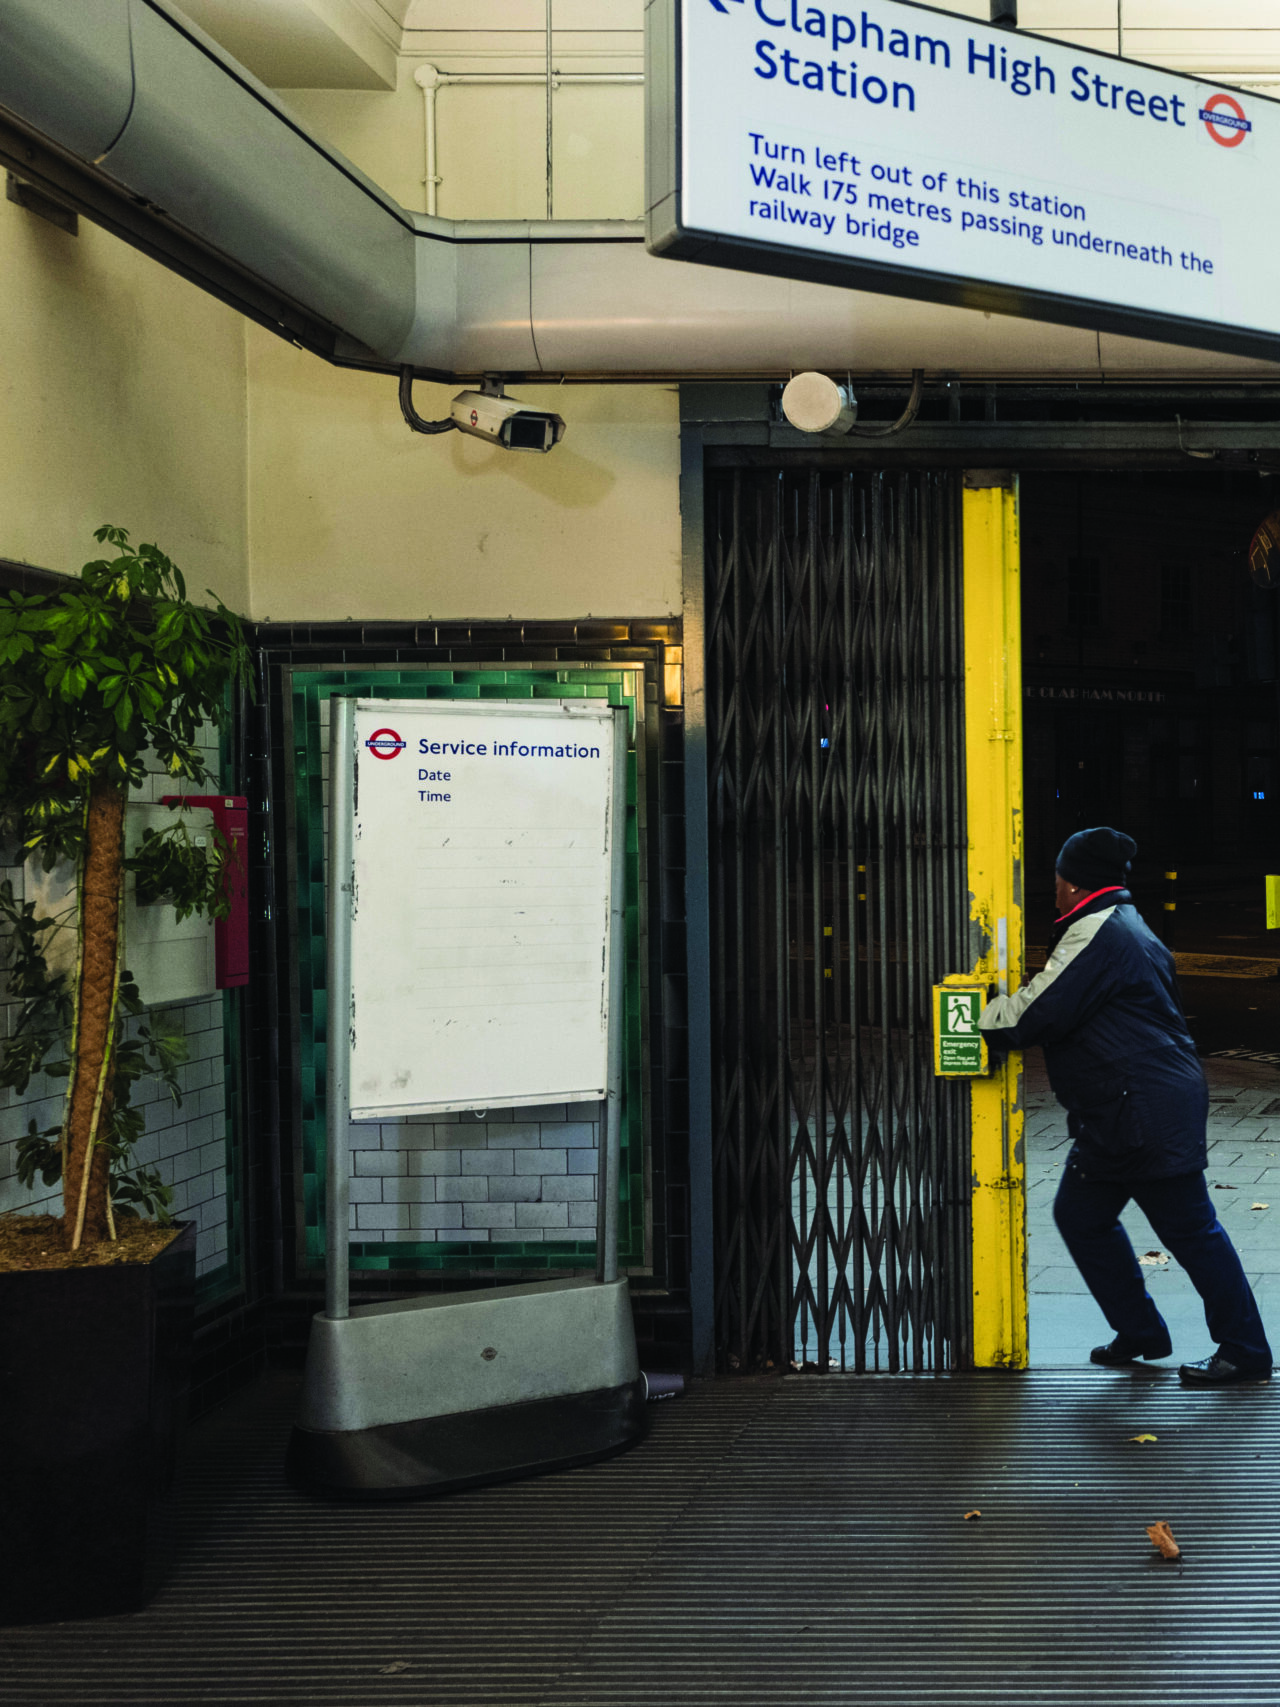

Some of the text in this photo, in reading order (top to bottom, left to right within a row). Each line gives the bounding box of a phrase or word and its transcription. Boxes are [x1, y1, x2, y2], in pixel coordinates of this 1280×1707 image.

[754, 0, 1186, 127] Clapham High Street
[754, 40, 916, 112] Station
[749, 133, 1086, 221] Turn left out of this station
[749, 197, 920, 248] railway bridge
[750, 165, 1214, 275] Walk 175 metres passing underneath the
[1116, 690, 1166, 702] NORTH
[418, 738, 600, 759] Service information
[418, 768, 451, 781] Date
[418, 790, 451, 802] Time
